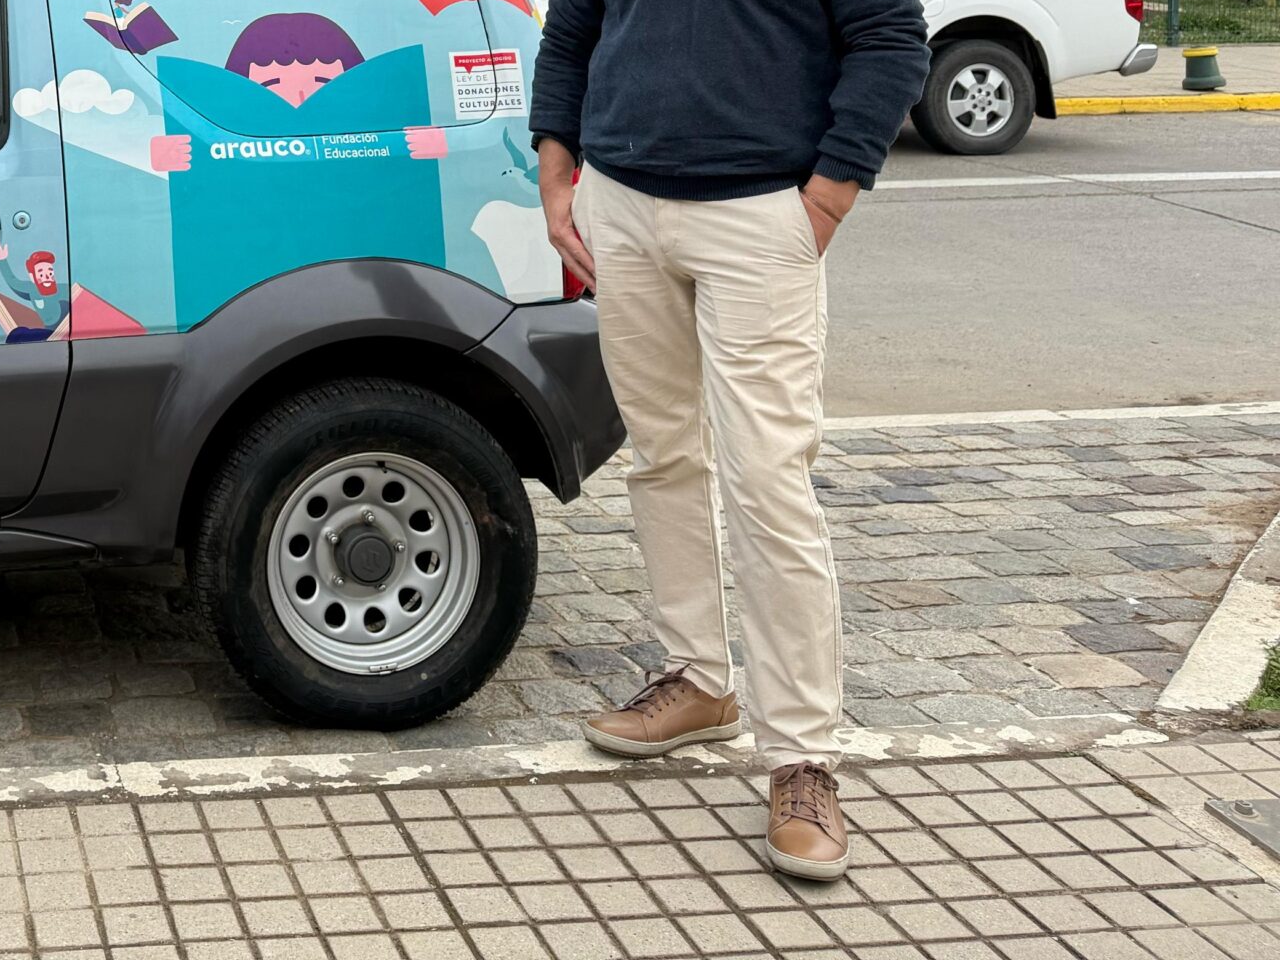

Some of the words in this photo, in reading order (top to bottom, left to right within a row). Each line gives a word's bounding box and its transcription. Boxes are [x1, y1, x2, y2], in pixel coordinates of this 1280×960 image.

[456, 75, 472, 83] LEY
[476, 74, 488, 82] DE
[457, 85, 520, 95] DONACIONES
[459, 99, 522, 108] CULTURALES
[322, 134, 378, 145] Fundación
[324, 147, 390, 159] Educacional
